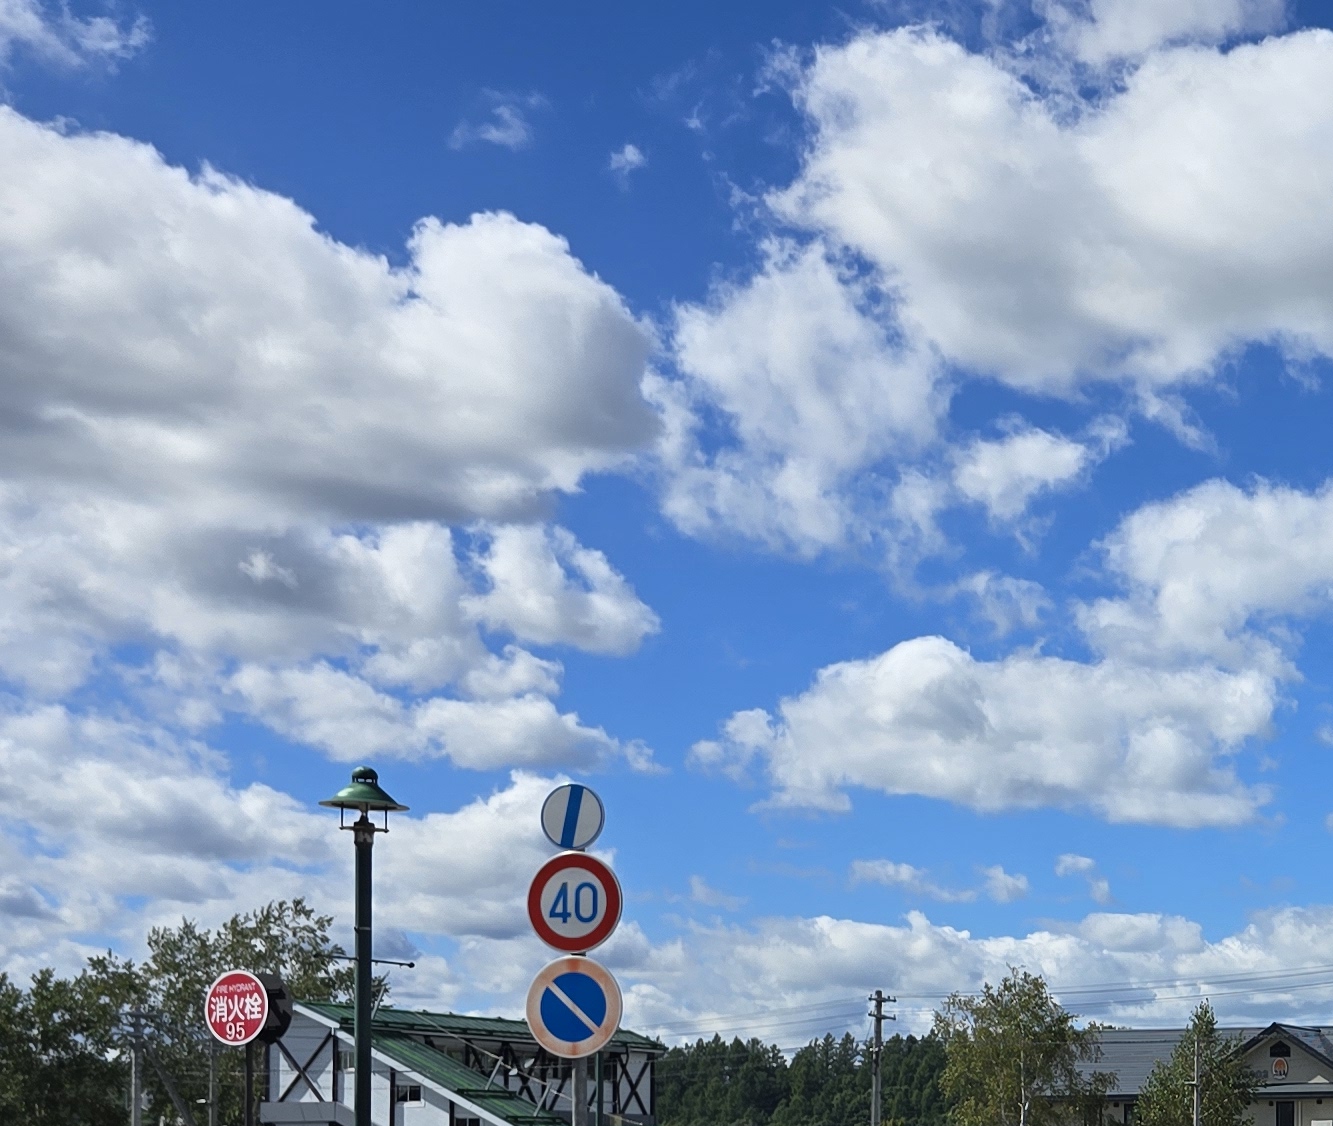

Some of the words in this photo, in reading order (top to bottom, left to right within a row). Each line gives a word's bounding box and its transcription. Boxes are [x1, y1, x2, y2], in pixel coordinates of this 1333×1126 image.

[549, 882, 598, 924] 40
[216, 984, 228, 994] FIRE
[229, 982, 256, 993] HYDRANT
[210, 992, 262, 1023] 消火栓
[226, 1022, 245, 1040] 95
